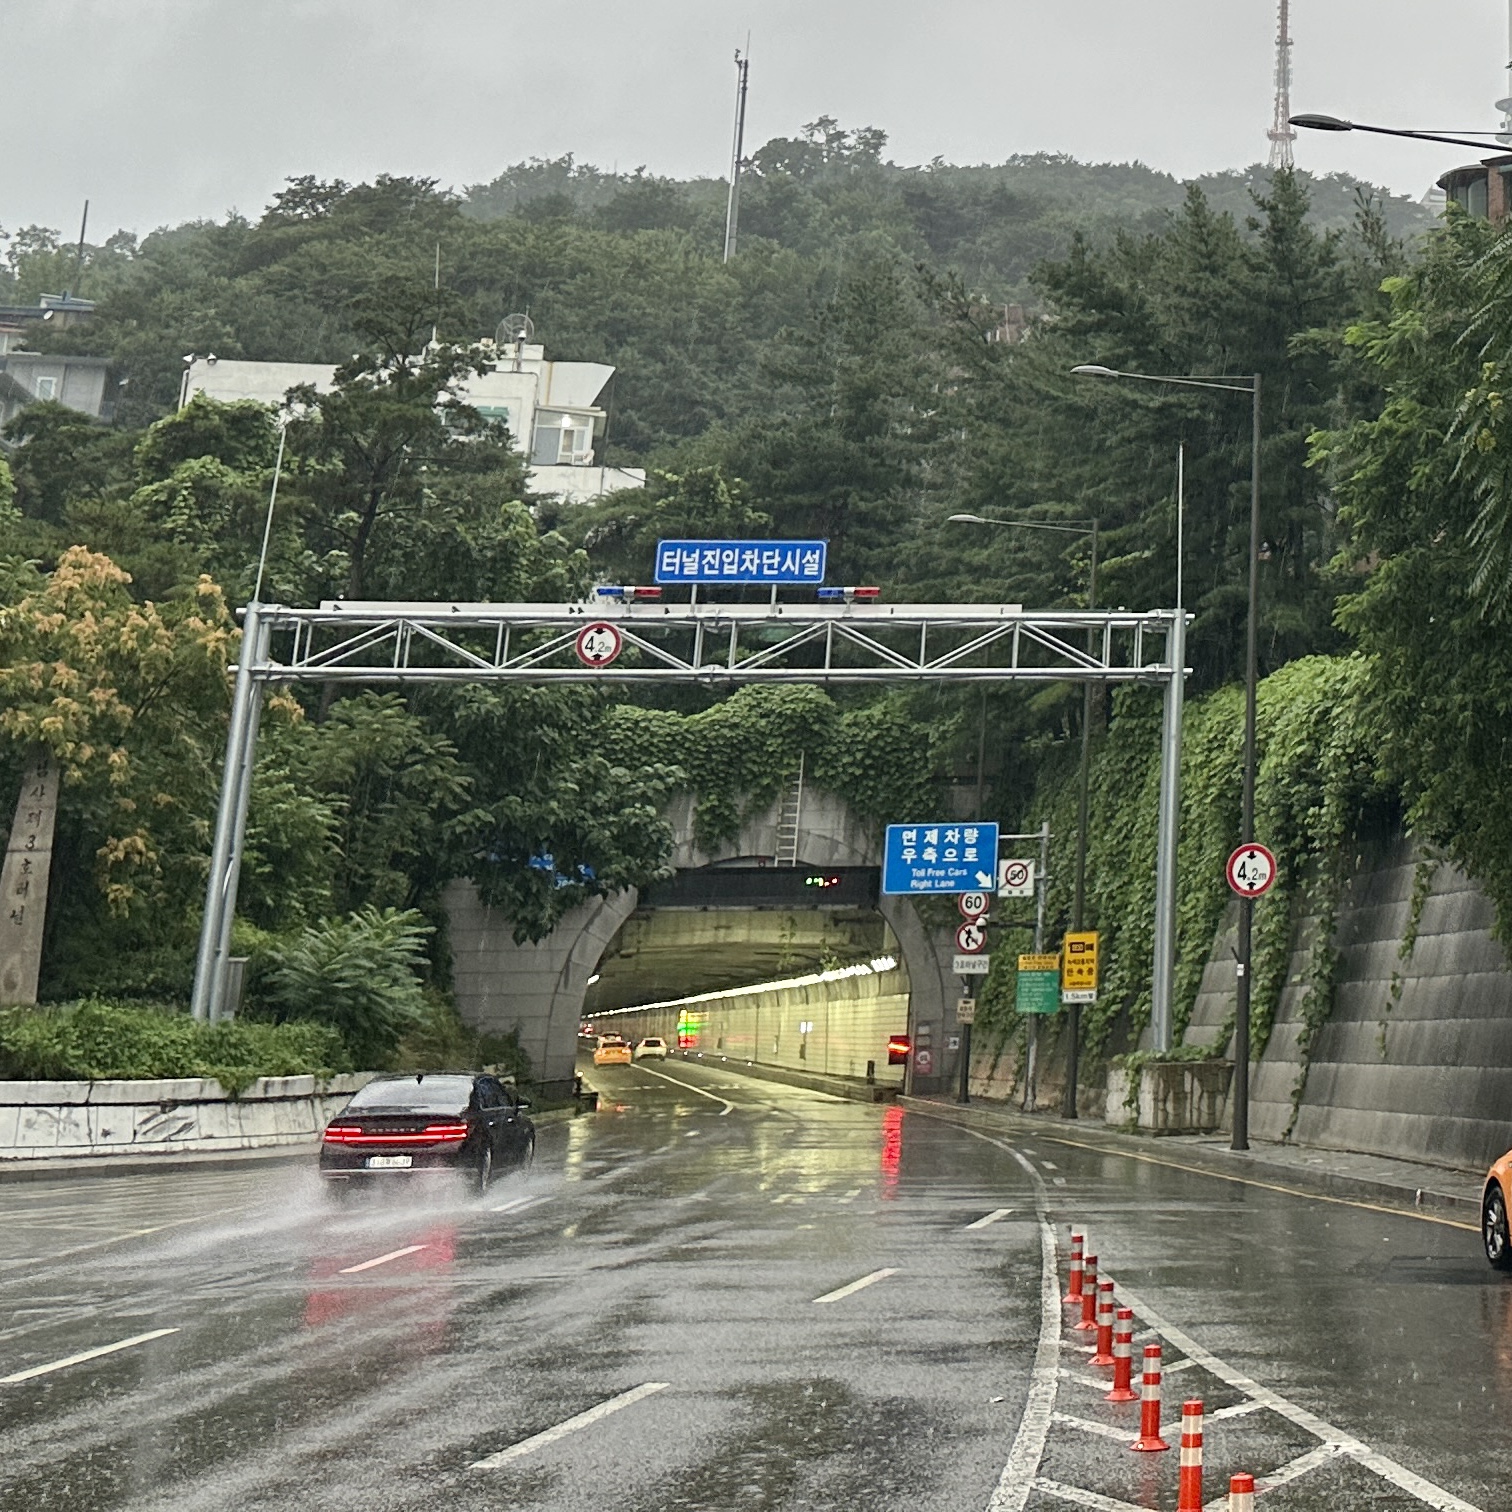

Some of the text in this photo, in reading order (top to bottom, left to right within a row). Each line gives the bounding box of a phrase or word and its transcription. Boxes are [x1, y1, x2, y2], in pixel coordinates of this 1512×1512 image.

[661, 548, 820, 576] 터널진입차단시설
[901, 847, 979, 864] 우측으로
[927, 868, 945, 877] Free
[948, 868, 968, 877] Cars
[1237, 861, 1267, 881] 4.2m
[934, 879, 955, 887] Lane
[965, 896, 982, 909] 60
